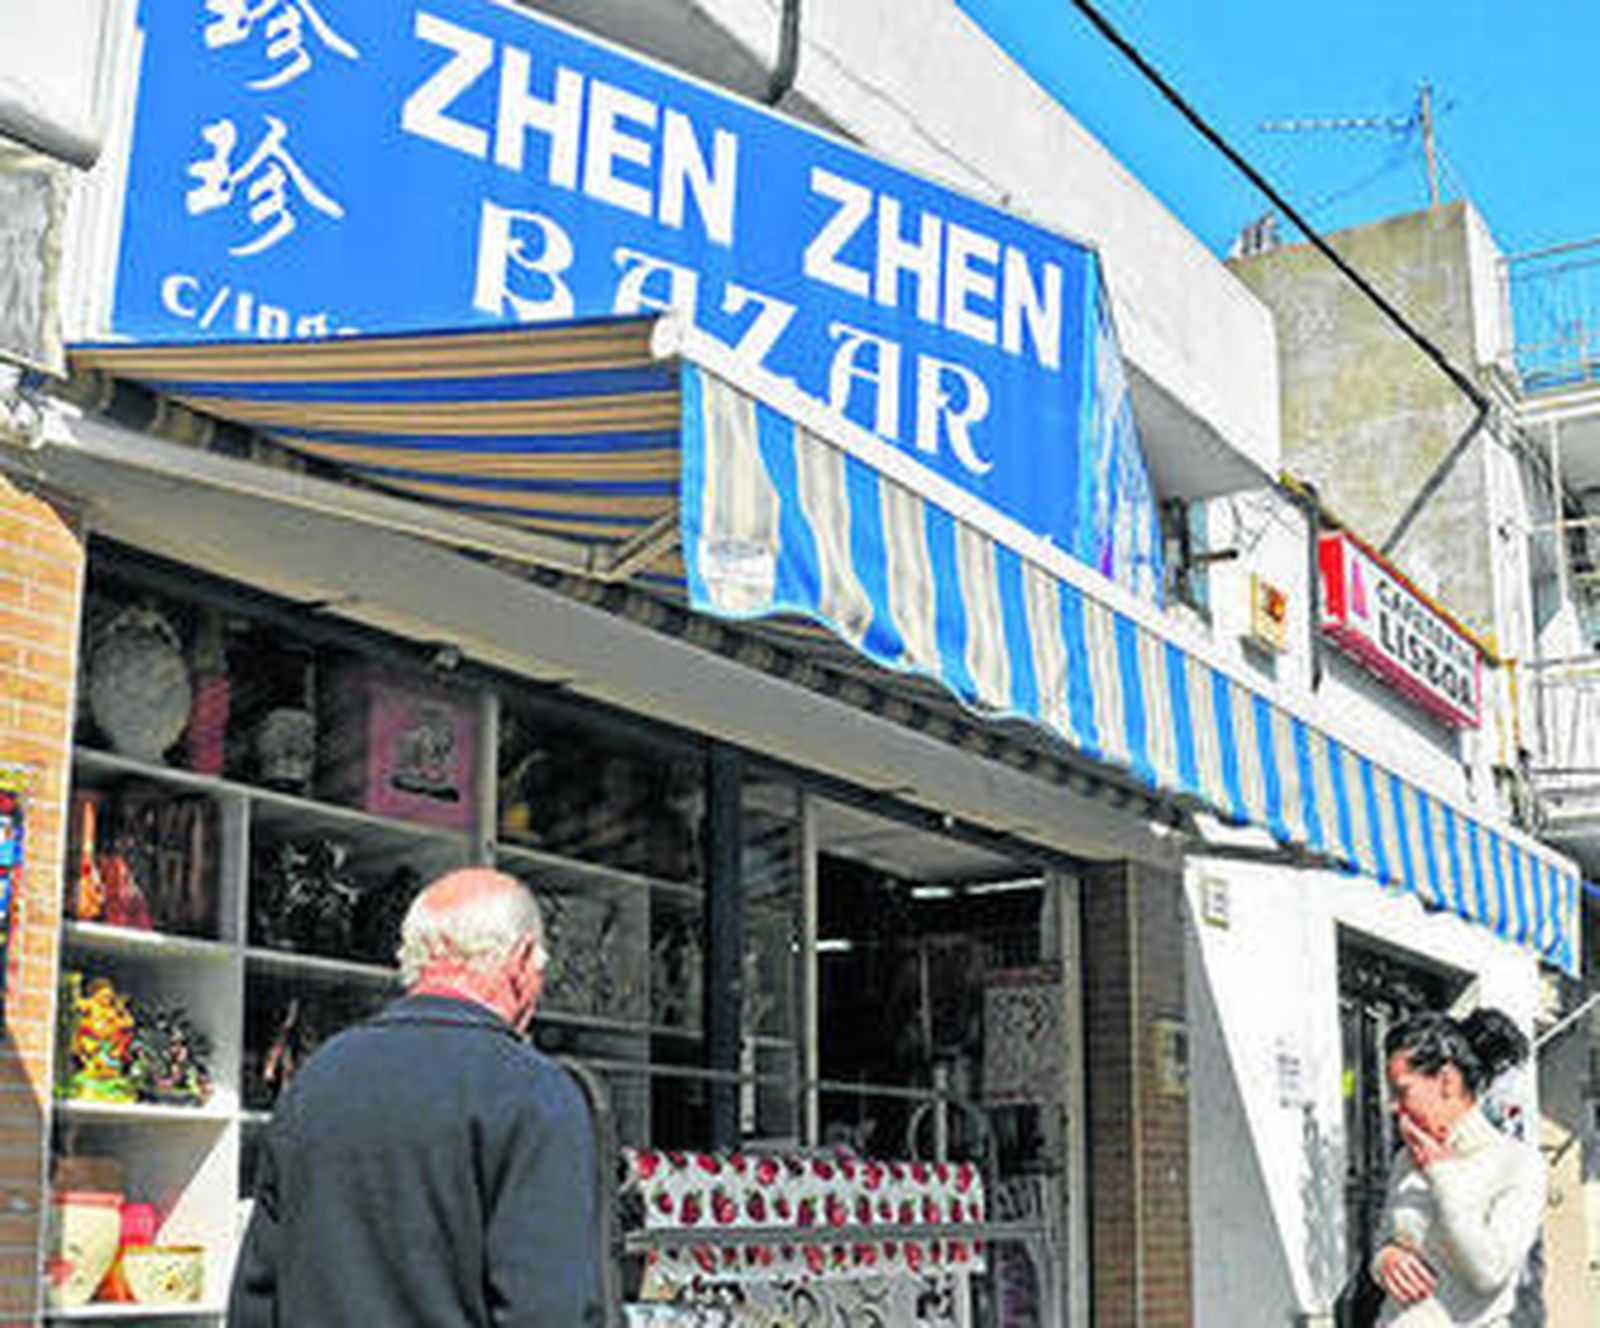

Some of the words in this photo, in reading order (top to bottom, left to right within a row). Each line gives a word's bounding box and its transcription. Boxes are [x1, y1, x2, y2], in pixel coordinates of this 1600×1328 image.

[402, 12, 737, 246] ZHEN
[803, 167, 1062, 370] ZHEN
[474, 200, 993, 475] BAZAR
